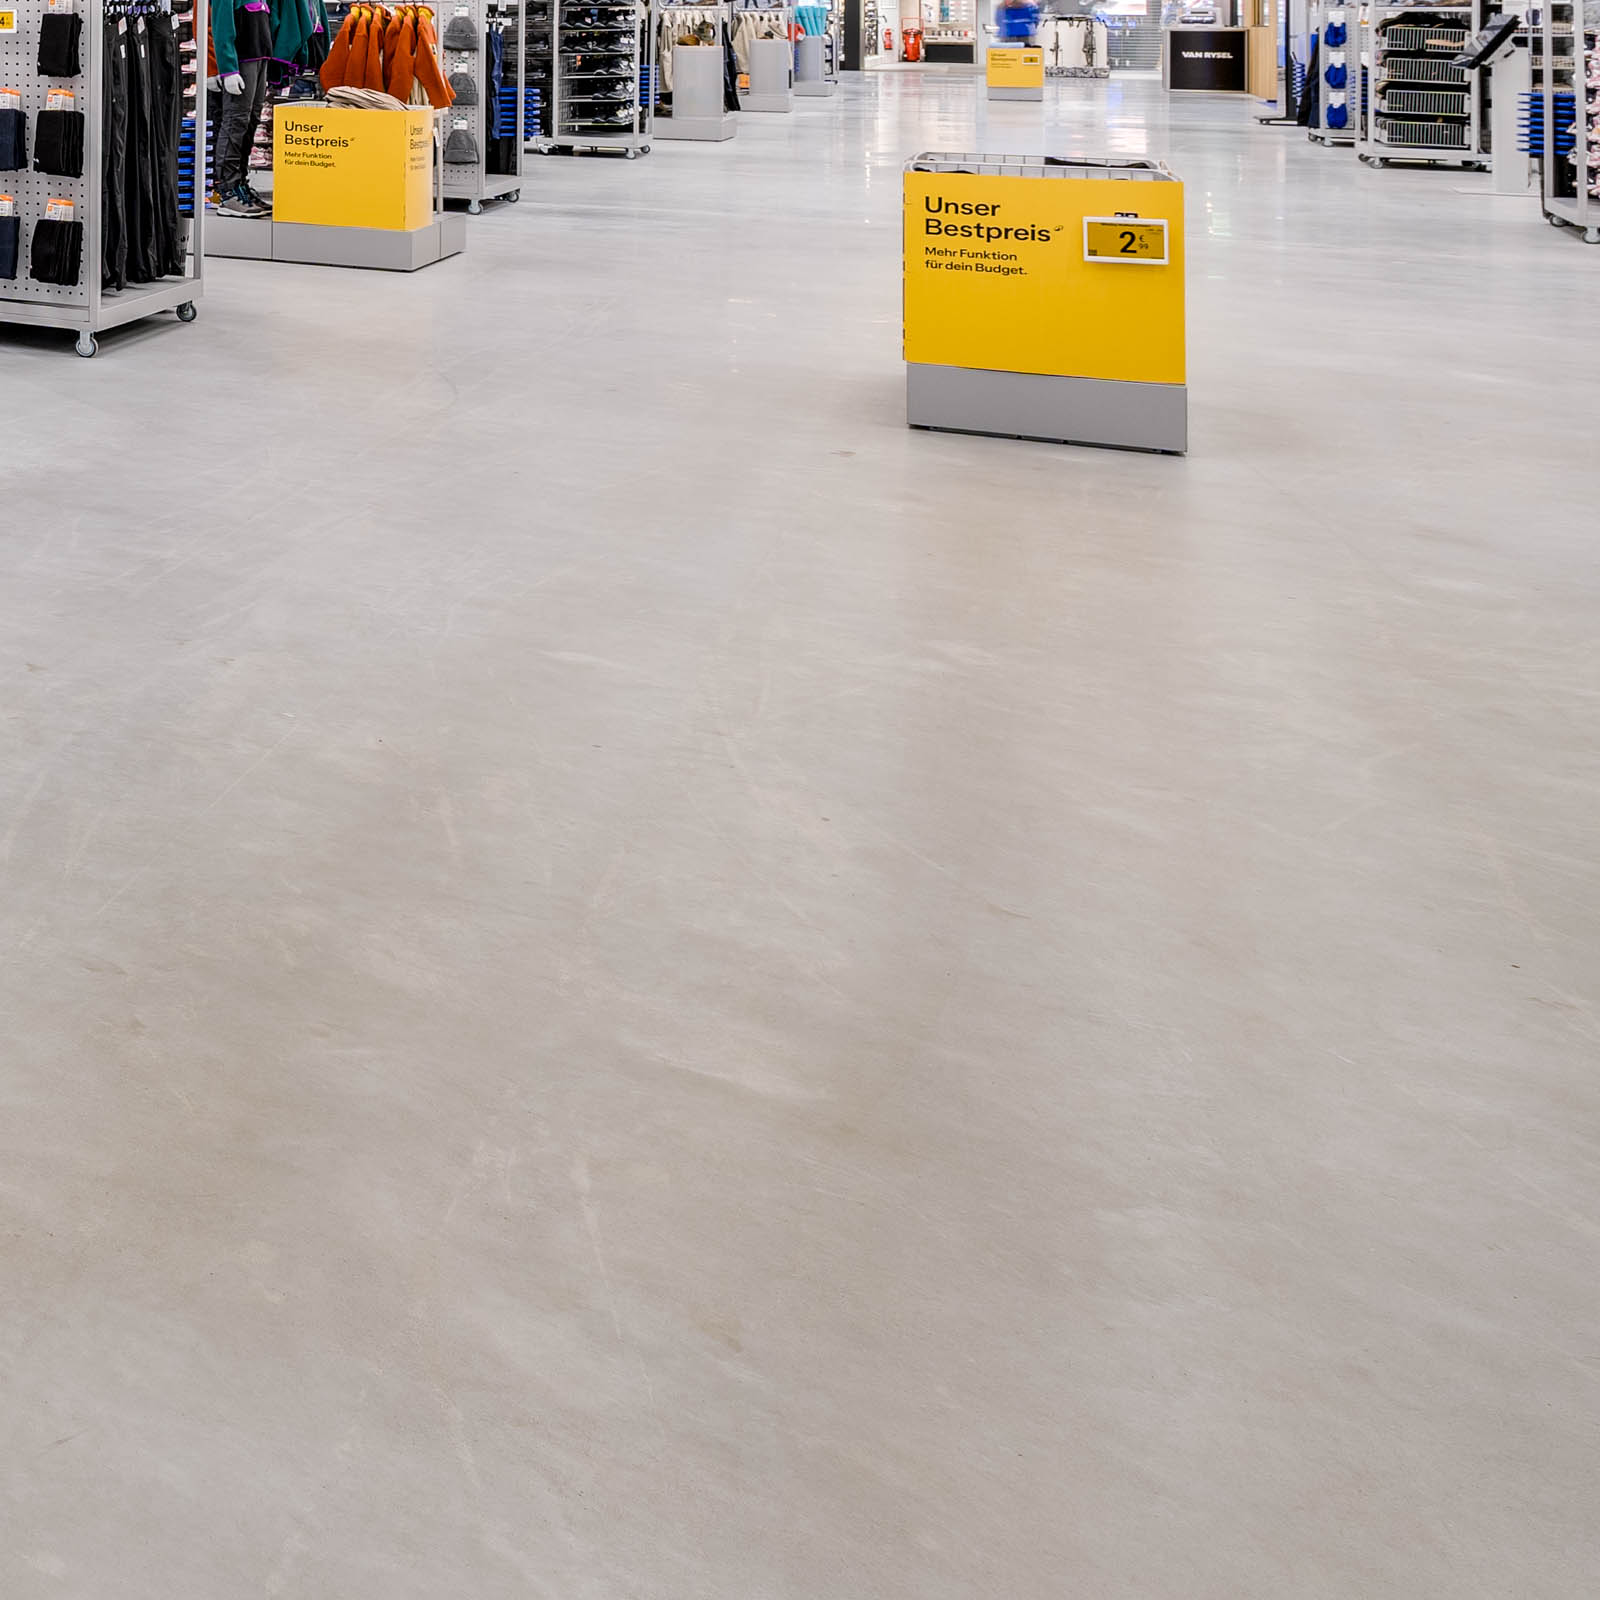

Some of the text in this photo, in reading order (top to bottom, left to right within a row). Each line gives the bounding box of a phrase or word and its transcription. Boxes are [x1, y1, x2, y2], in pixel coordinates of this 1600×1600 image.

[0, 16, 6, 26] 4
[1181, 51, 1234, 59] VAN RYSEL
[284, 121, 324, 133] Unser
[284, 134, 349, 149] Bestpreis
[284, 151, 333, 160] Mehr Funktion
[310, 160, 337, 168] Budget.
[924, 195, 1001, 217] Unser
[924, 218, 1051, 243] Bestpreis
[1119, 231, 1138, 254] 2
[924, 246, 1018, 261] Mehr Funktion
[924, 259, 1028, 276] für dein Budget.
